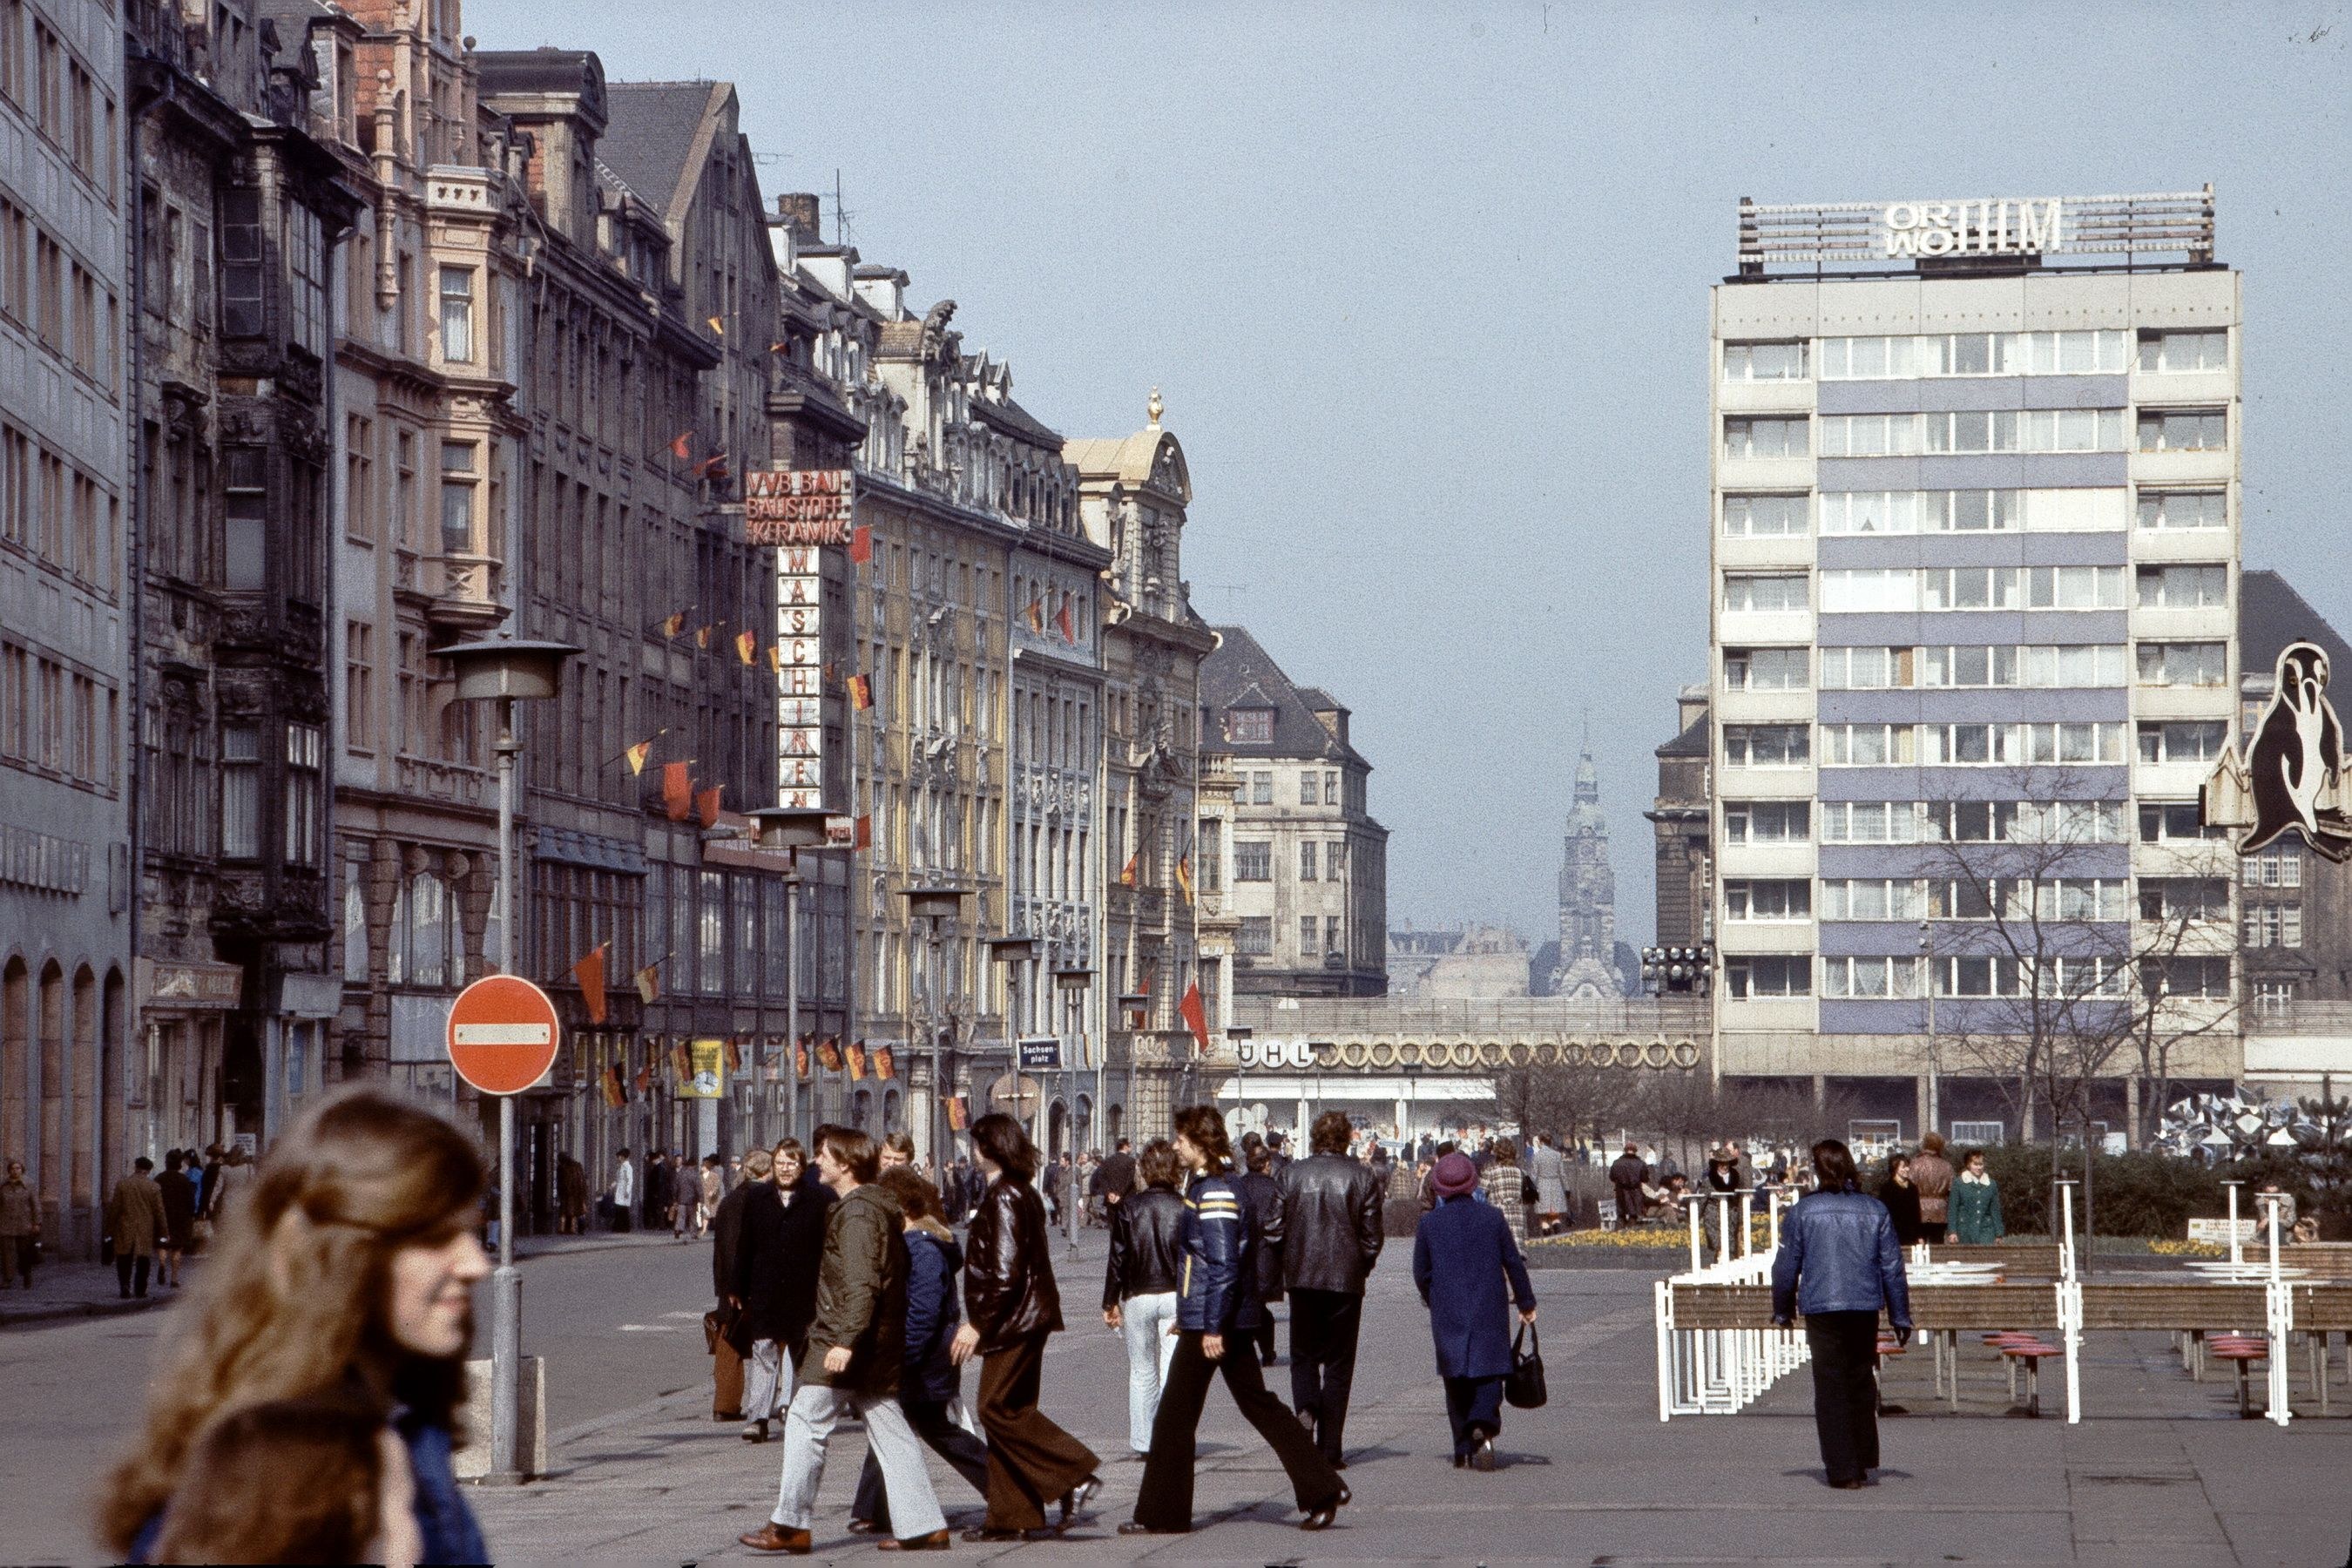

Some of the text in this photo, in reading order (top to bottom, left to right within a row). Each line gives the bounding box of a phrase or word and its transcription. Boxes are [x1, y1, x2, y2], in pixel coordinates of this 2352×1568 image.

[1885, 204, 1952, 230] OR
[1885, 230, 1954, 256] WO
[747, 470, 841, 493] VVB BAU
[789, 548, 808, 808] MASCHINEN
[1023, 1045, 1057, 1054] Sachsen-
[1031, 1055, 1049, 1064] platz
